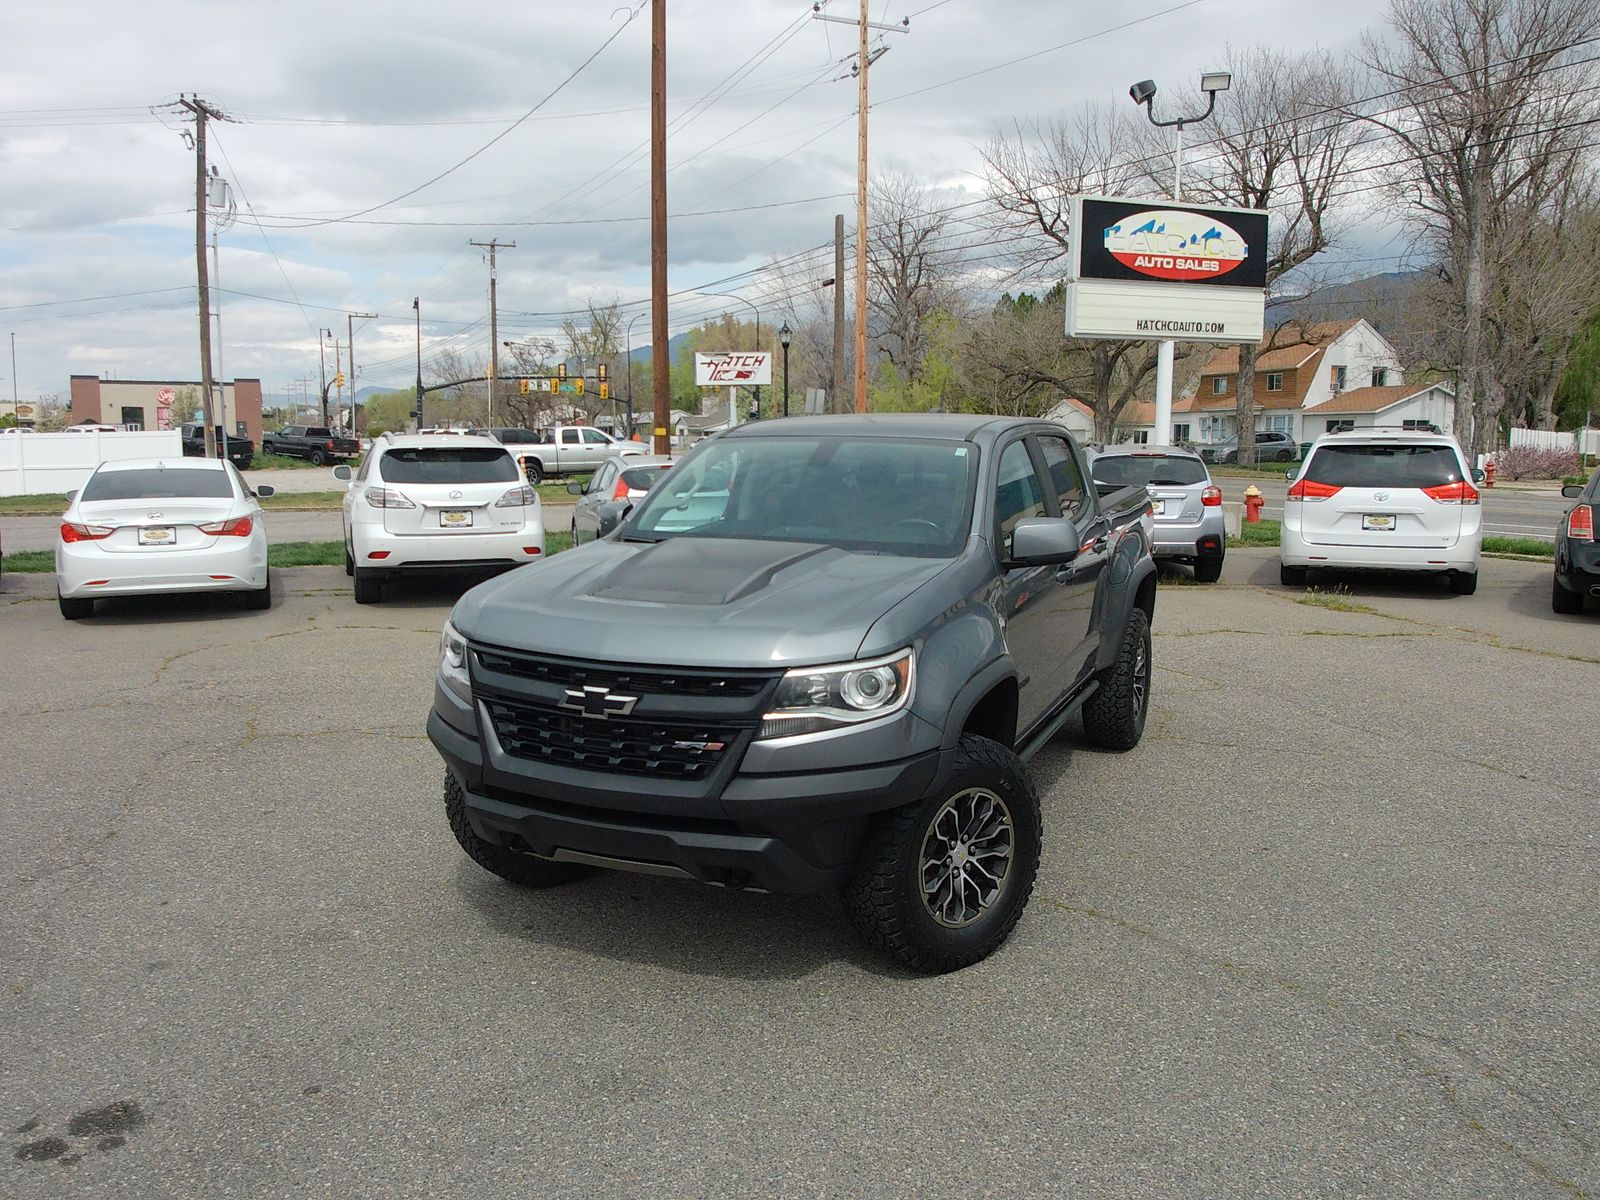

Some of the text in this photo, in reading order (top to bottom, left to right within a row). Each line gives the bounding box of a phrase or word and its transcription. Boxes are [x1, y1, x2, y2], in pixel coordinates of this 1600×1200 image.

[1134, 257, 1220, 272] AUTO SALES
[1136, 319, 1225, 333] HATCHCOAUTO.COM
